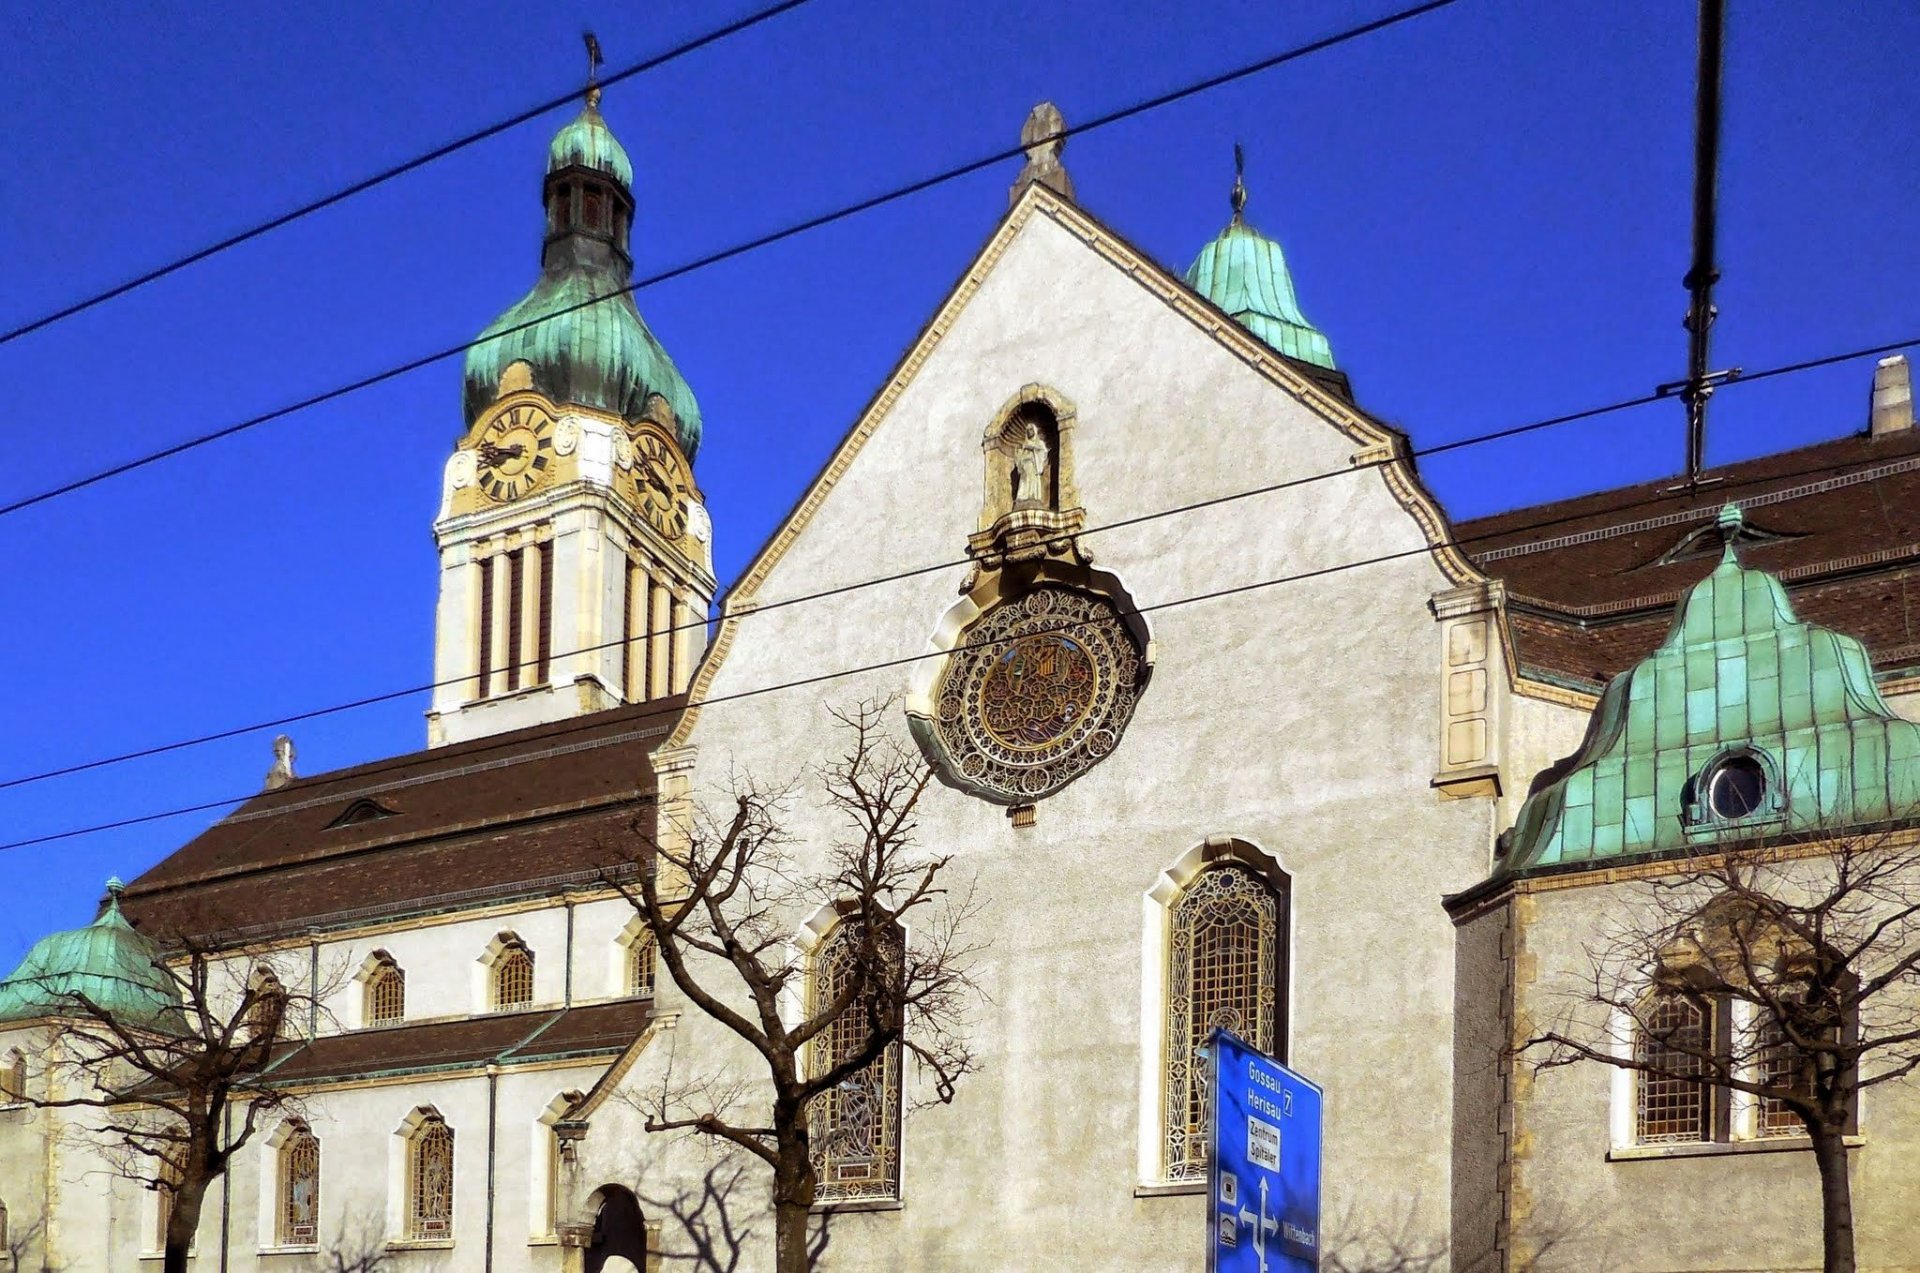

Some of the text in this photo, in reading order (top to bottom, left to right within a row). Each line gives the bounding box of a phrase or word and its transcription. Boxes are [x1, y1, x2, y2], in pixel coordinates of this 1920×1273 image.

[1249, 1061, 1280, 1094] Gossau
[1248, 1087, 1281, 1120] Herisau
[1285, 1093, 1291, 1111] 7
[1250, 1120, 1278, 1145] Zentrum
